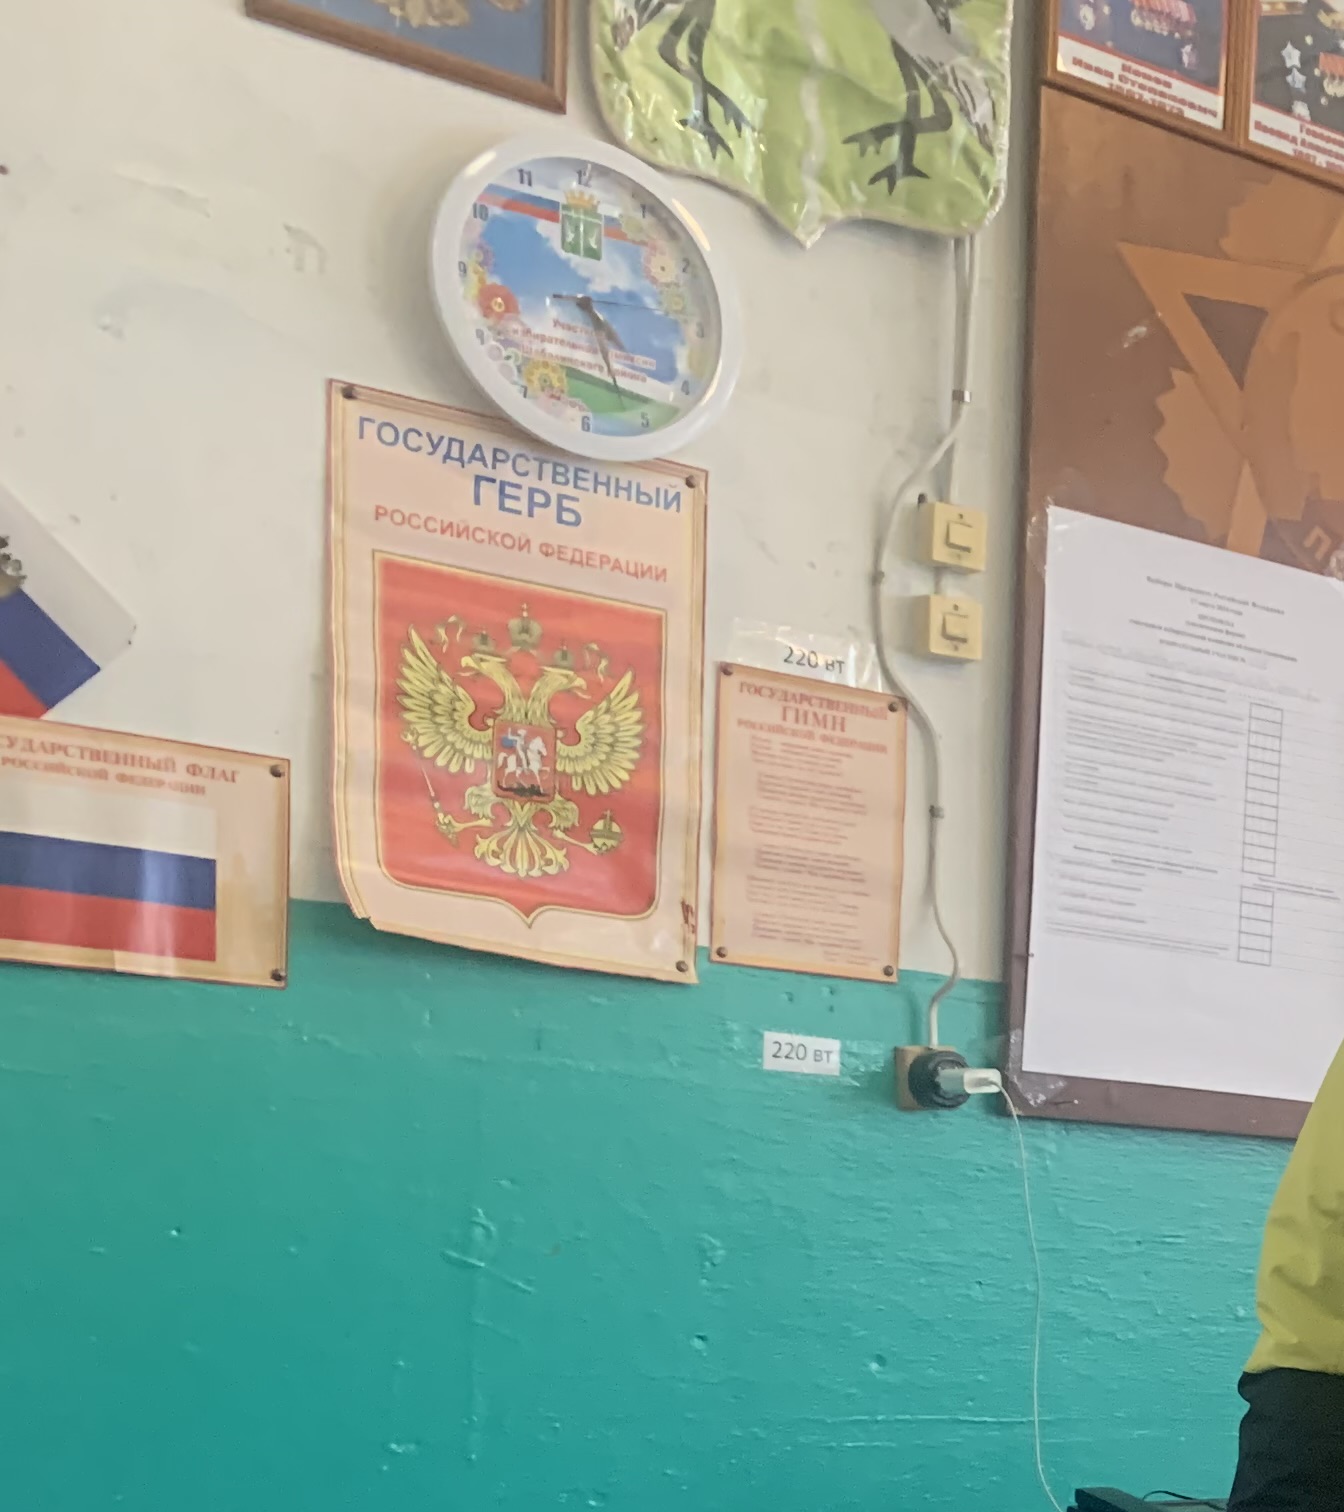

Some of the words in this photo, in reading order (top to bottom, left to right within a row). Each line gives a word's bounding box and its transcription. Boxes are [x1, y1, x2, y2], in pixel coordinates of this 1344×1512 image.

[518, 167, 533, 187] 11
[472, 203, 489, 222] 10
[681, 257, 691, 273] 2
[681, 379, 690, 396] 4
[581, 416, 591, 433] 6
[641, 412, 650, 428] 5
[358, 416, 682, 513] ГОСУДАРСТВЕННЫЙ
[473, 474, 582, 527] ГЕРБ
[374, 505, 531, 554] РОССИЙСКОЙ
[538, 541, 668, 583] ФЕДЕРАЦИИ
[783, 646, 819, 669] 220
[739, 680, 888, 720] ГОСУДАРСТВЕННЫЙ
[781, 705, 847, 733] ГИМН
[186, 762, 241, 784] ФЛАГ
[772, 1041, 807, 1061] 220
